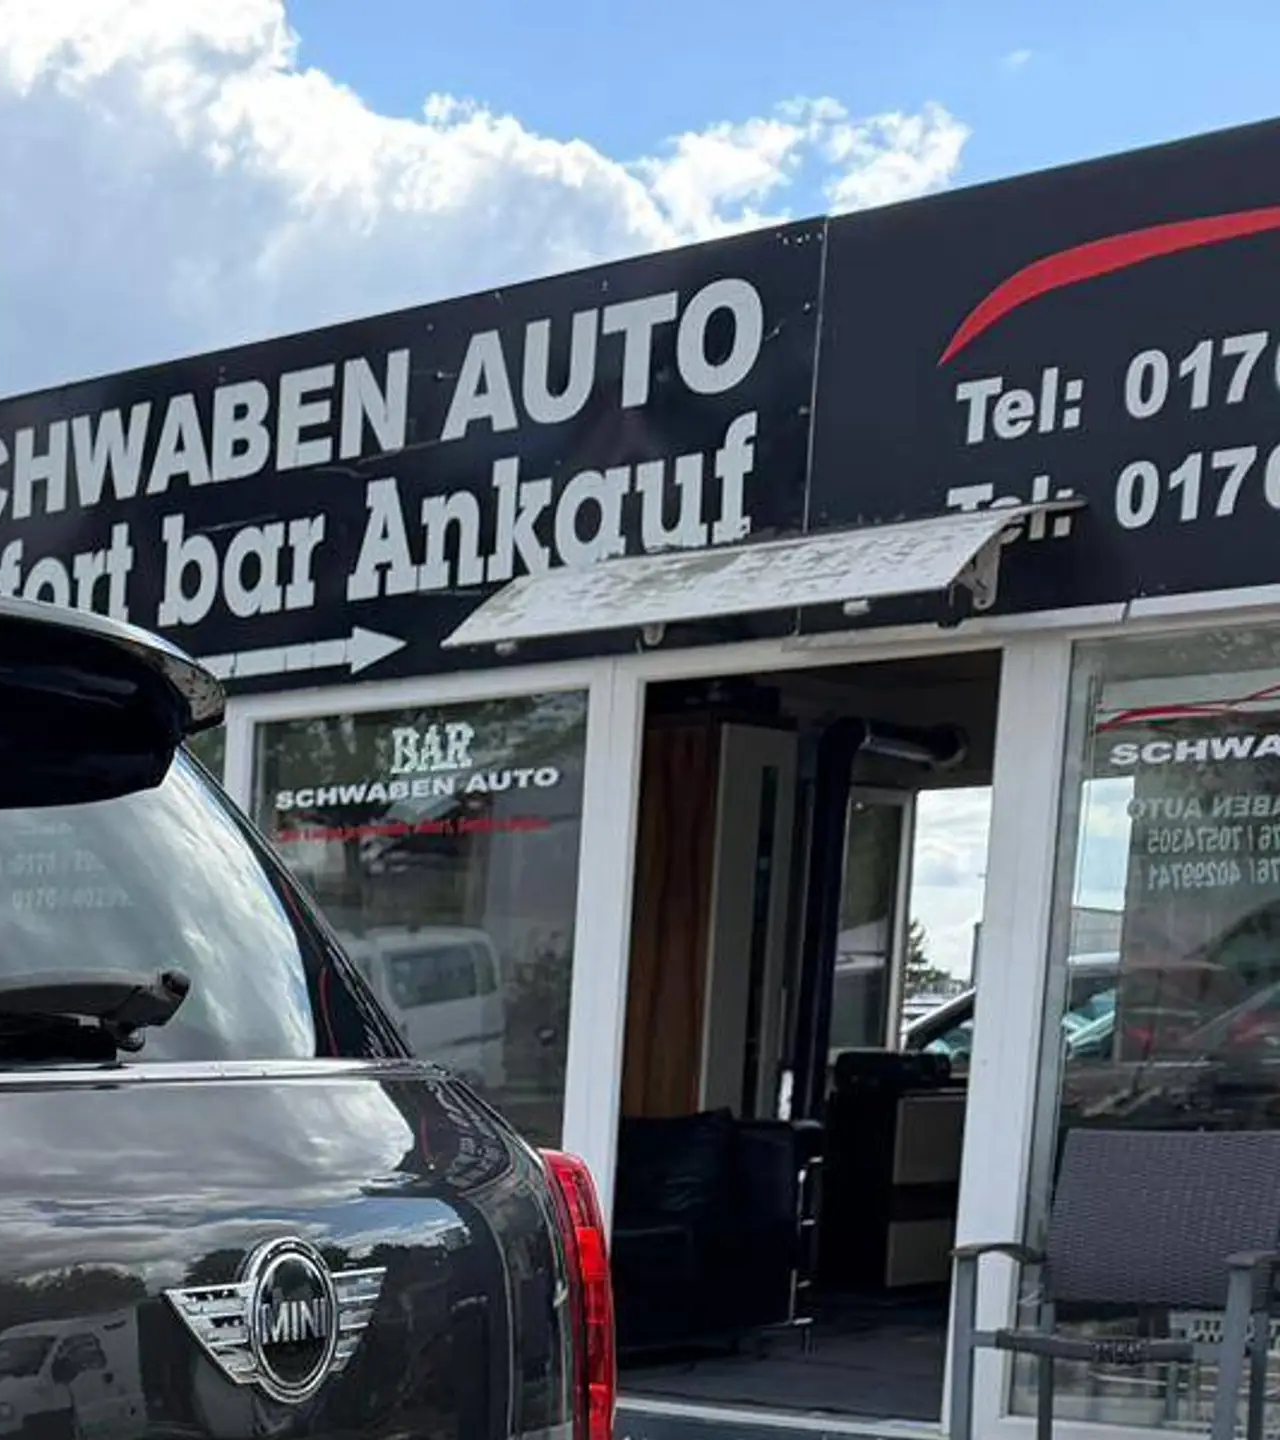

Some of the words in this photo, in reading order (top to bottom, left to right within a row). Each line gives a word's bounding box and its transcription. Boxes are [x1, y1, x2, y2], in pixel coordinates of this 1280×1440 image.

[441, 276, 765, 443] AUTO
[956, 367, 1083, 445] Tel:
[1125, 331, 1280, 419] 017
[157, 508, 326, 627] bar
[346, 411, 757, 603] Ankauf
[274, 775, 455, 811] SCHWABEN
[464, 766, 560, 794] AUTO
[391, 721, 476, 774] BAR
[261, 1296, 329, 1345] MINI
